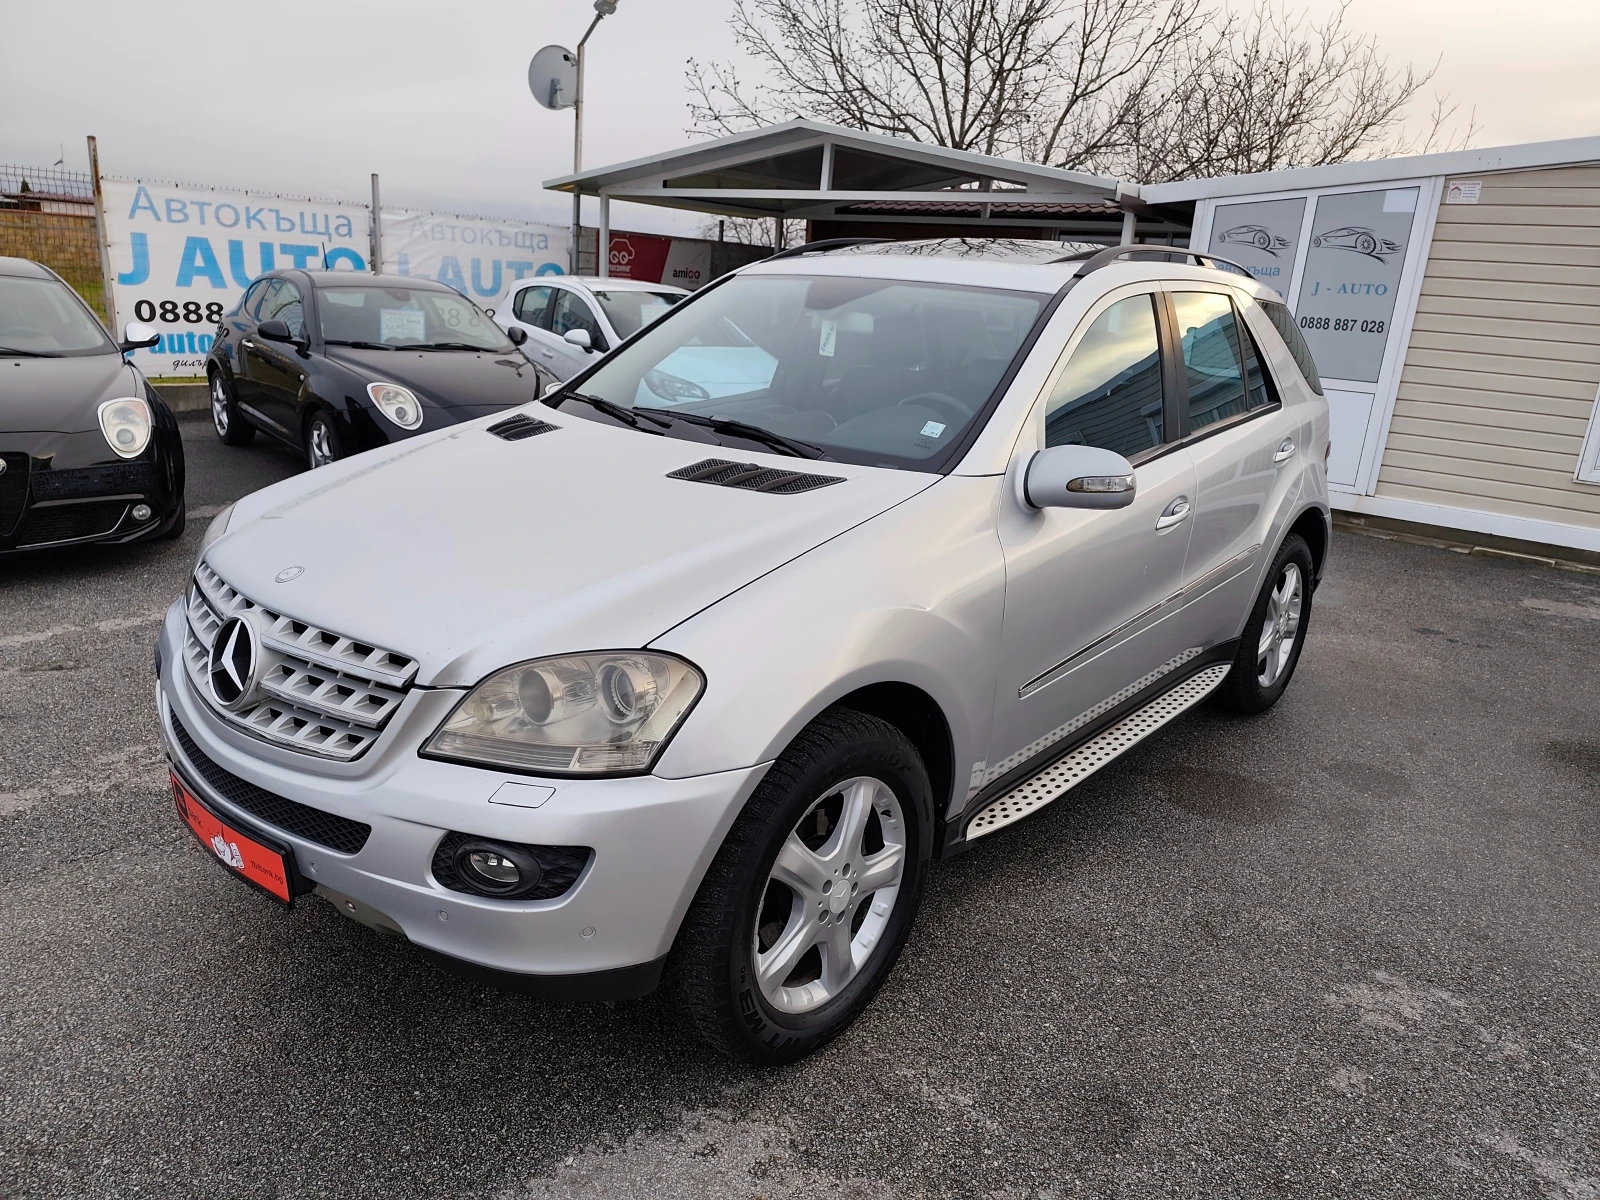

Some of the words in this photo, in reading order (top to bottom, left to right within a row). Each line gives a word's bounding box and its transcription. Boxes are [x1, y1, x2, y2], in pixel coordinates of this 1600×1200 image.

[127, 185, 354, 243] Автокъща
[408, 215, 549, 253] Автокъща
[117, 232, 151, 286] J
[1217, 264, 1281, 278] авткъща
[1311, 281, 1322, 297] J
[1336, 283, 1389, 297] AUTO
[134, 299, 225, 324] 0888
[1299, 315, 1331, 331] 0888
[1333, 317, 1358, 332] 887
[1360, 319, 1386, 334] 028
[148, 331, 218, 355] auto
